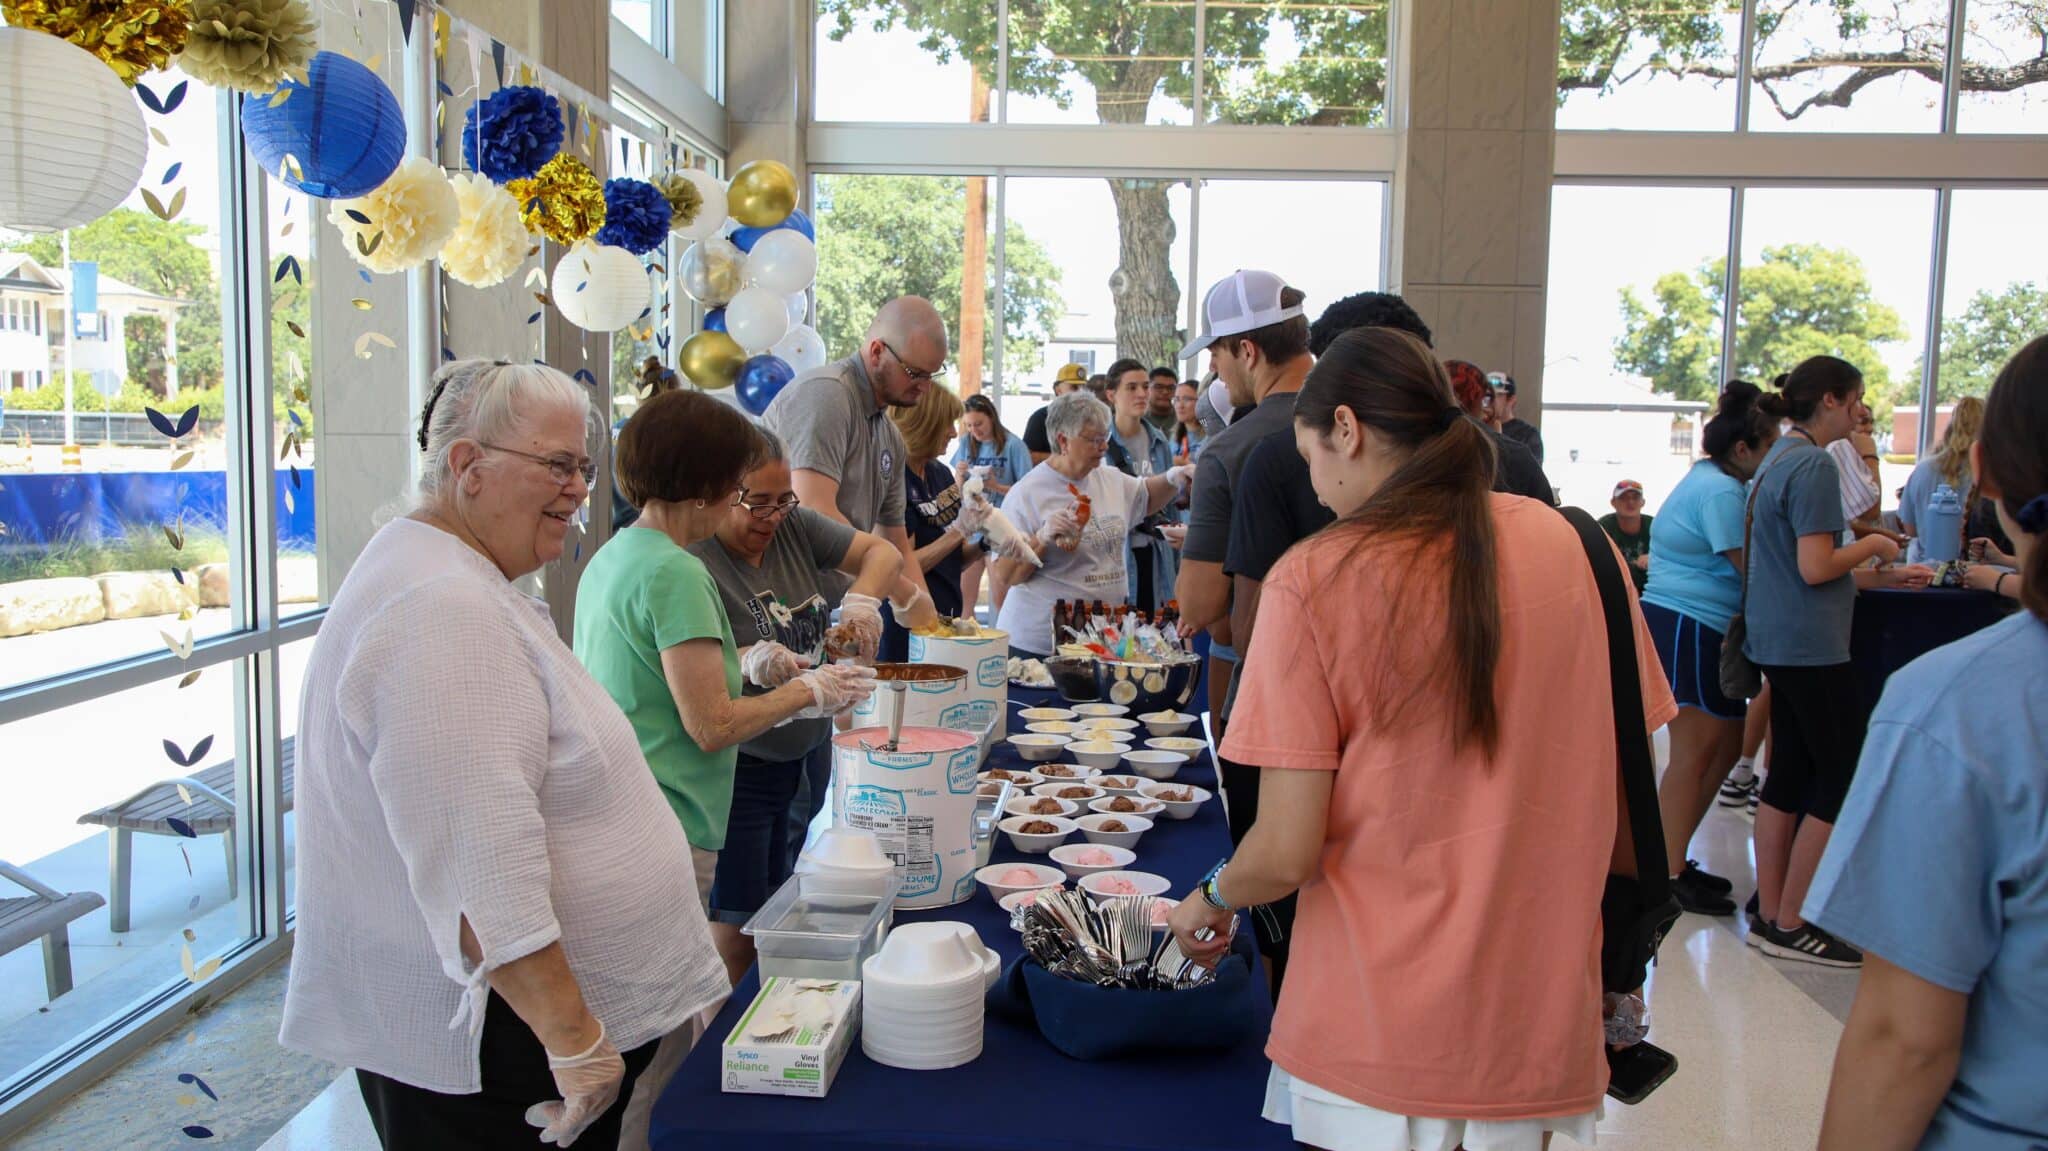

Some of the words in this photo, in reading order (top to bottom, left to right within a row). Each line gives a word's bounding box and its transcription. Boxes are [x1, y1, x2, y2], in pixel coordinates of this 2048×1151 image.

[737, 1051, 759, 1061] Sysco
[801, 1053, 819, 1062] Vinyl
[726, 1060, 769, 1072] Reliance
[794, 1061, 819, 1069] Gloves
